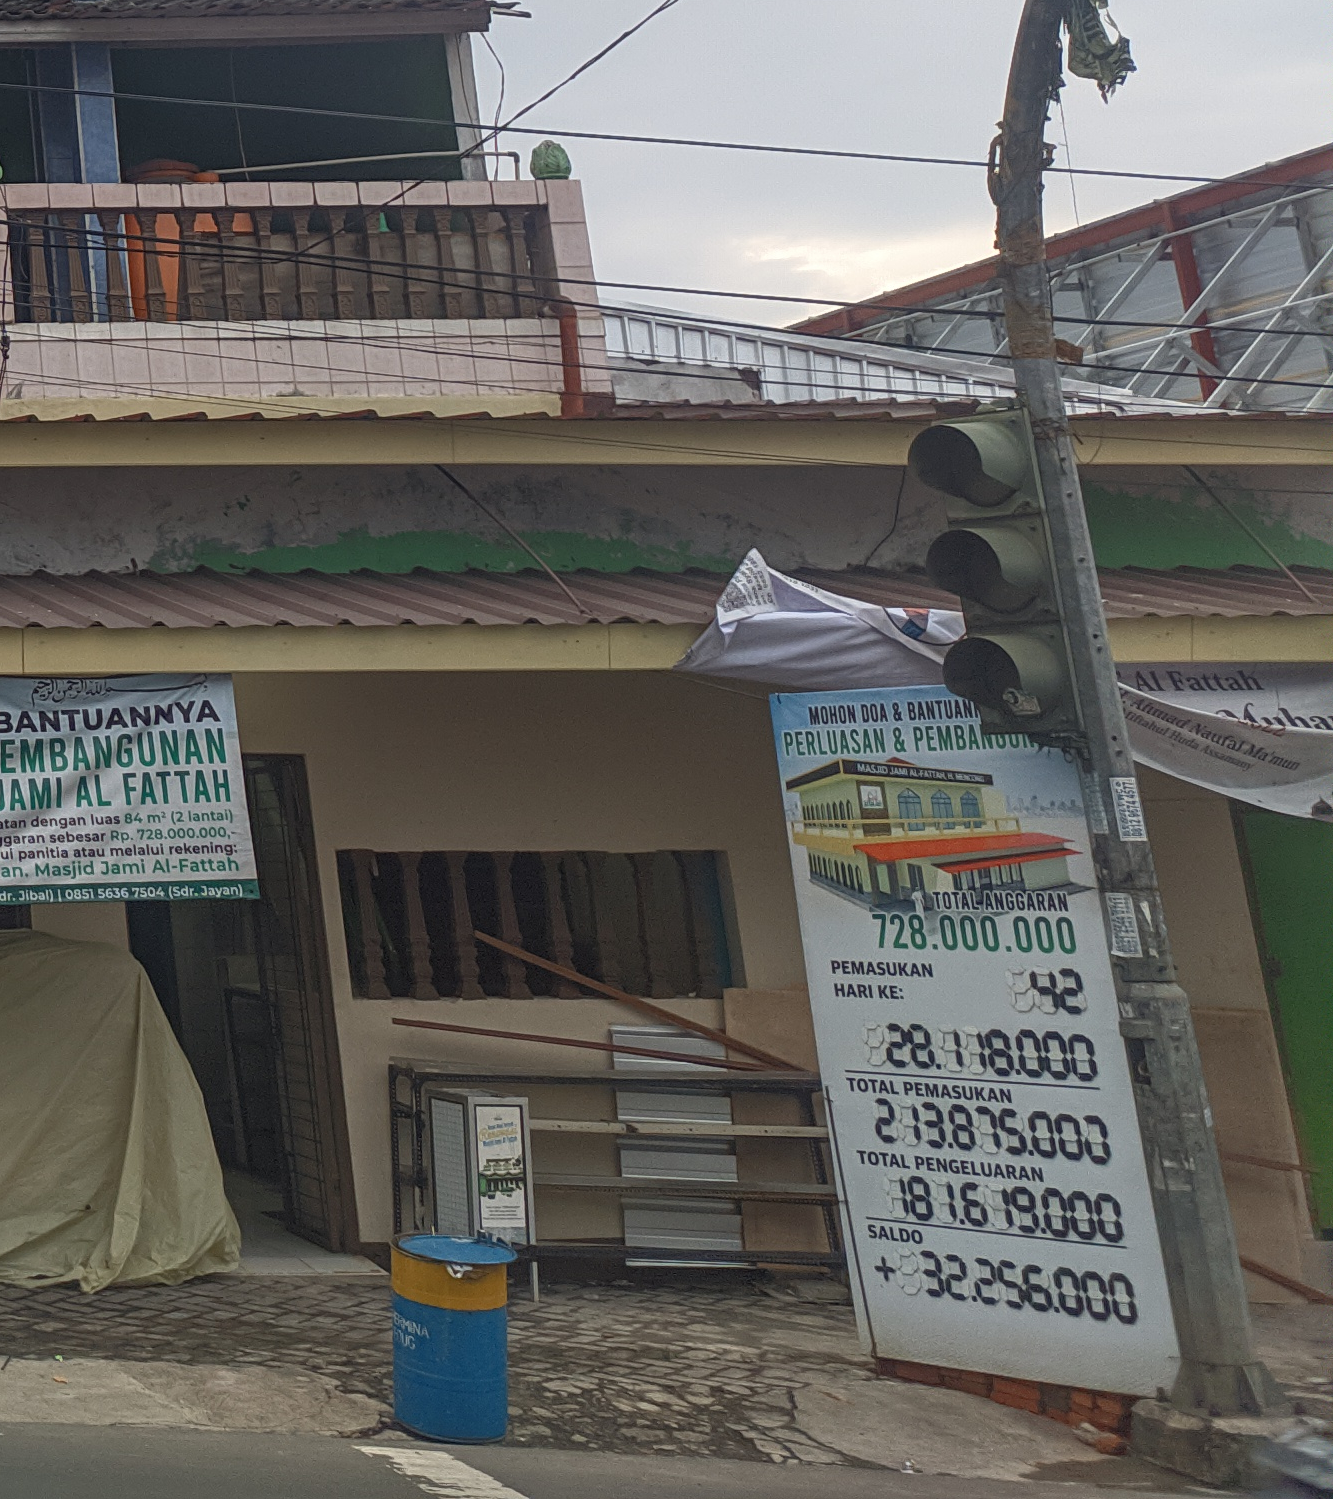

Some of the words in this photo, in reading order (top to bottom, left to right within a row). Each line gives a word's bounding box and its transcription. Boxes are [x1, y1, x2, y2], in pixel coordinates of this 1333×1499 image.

[1135, 670, 1165, 691] Al
[1166, 670, 1265, 691] Fattah
[808, 704, 857, 726] MOHON
[861, 702, 888, 723] DOA
[892, 701, 903, 722] &
[1123, 707, 1169, 736] iftahul
[1166, 730, 1200, 751] Huda
[1129, 698, 1191, 729] Ahmad
[1189, 722, 1247, 753] Naufal
[1244, 743, 1301, 771] Ma'mun
[783, 726, 885, 756] PERLUASAN
[893, 726, 907, 753] &
[856, 763, 888, 775] MASJID
[75, 774, 112, 809] AL
[122, 769, 232, 805] FATTAH
[32, 816, 86, 830] dengan
[90, 813, 121, 827] luas
[124, 812, 143, 825] 84
[170, 810, 185, 825] (2
[187, 808, 234, 823] lantai)
[49, 830, 106, 844] sebesar
[110, 829, 134, 844] Rp.
[137, 826, 237, 841] 728.000.000,-
[18, 847, 69, 862] panitia
[73, 845, 106, 858] atau
[110, 844, 165, 857] melalui
[169, 842, 237, 857] rekening:
[0, 865, 29, 879] an.
[35, 860, 95, 880] Masjid
[100, 859, 146, 875] Jami
[152, 857, 239, 874] Al-Fattah
[18, 888, 55, 903] Jibal)
[65, 888, 94, 901] 0851
[98, 887, 130, 900] 5636
[131, 887, 165, 899] 7504
[168, 885, 198, 899] (Sdr.
[200, 884, 243, 899] Jayan)
[932, 891, 981, 911] TOTAL
[985, 892, 1069, 912] ANGGARAN
[872, 913, 1077, 955] 728.000.000
[831, 960, 934, 978] PEMASUKAN
[834, 983, 873, 999] HARI
[878, 984, 905, 1000] KE:
[1029, 967, 1084, 1015] 42
[846, 1077, 899, 1095] TOTAL
[903, 1081, 1013, 1103] PEMASUKAN
[856, 1150, 910, 1170] TOTAL
[914, 1155, 1045, 1183] PENGELUARAN
[867, 1224, 923, 1244] SALDO
